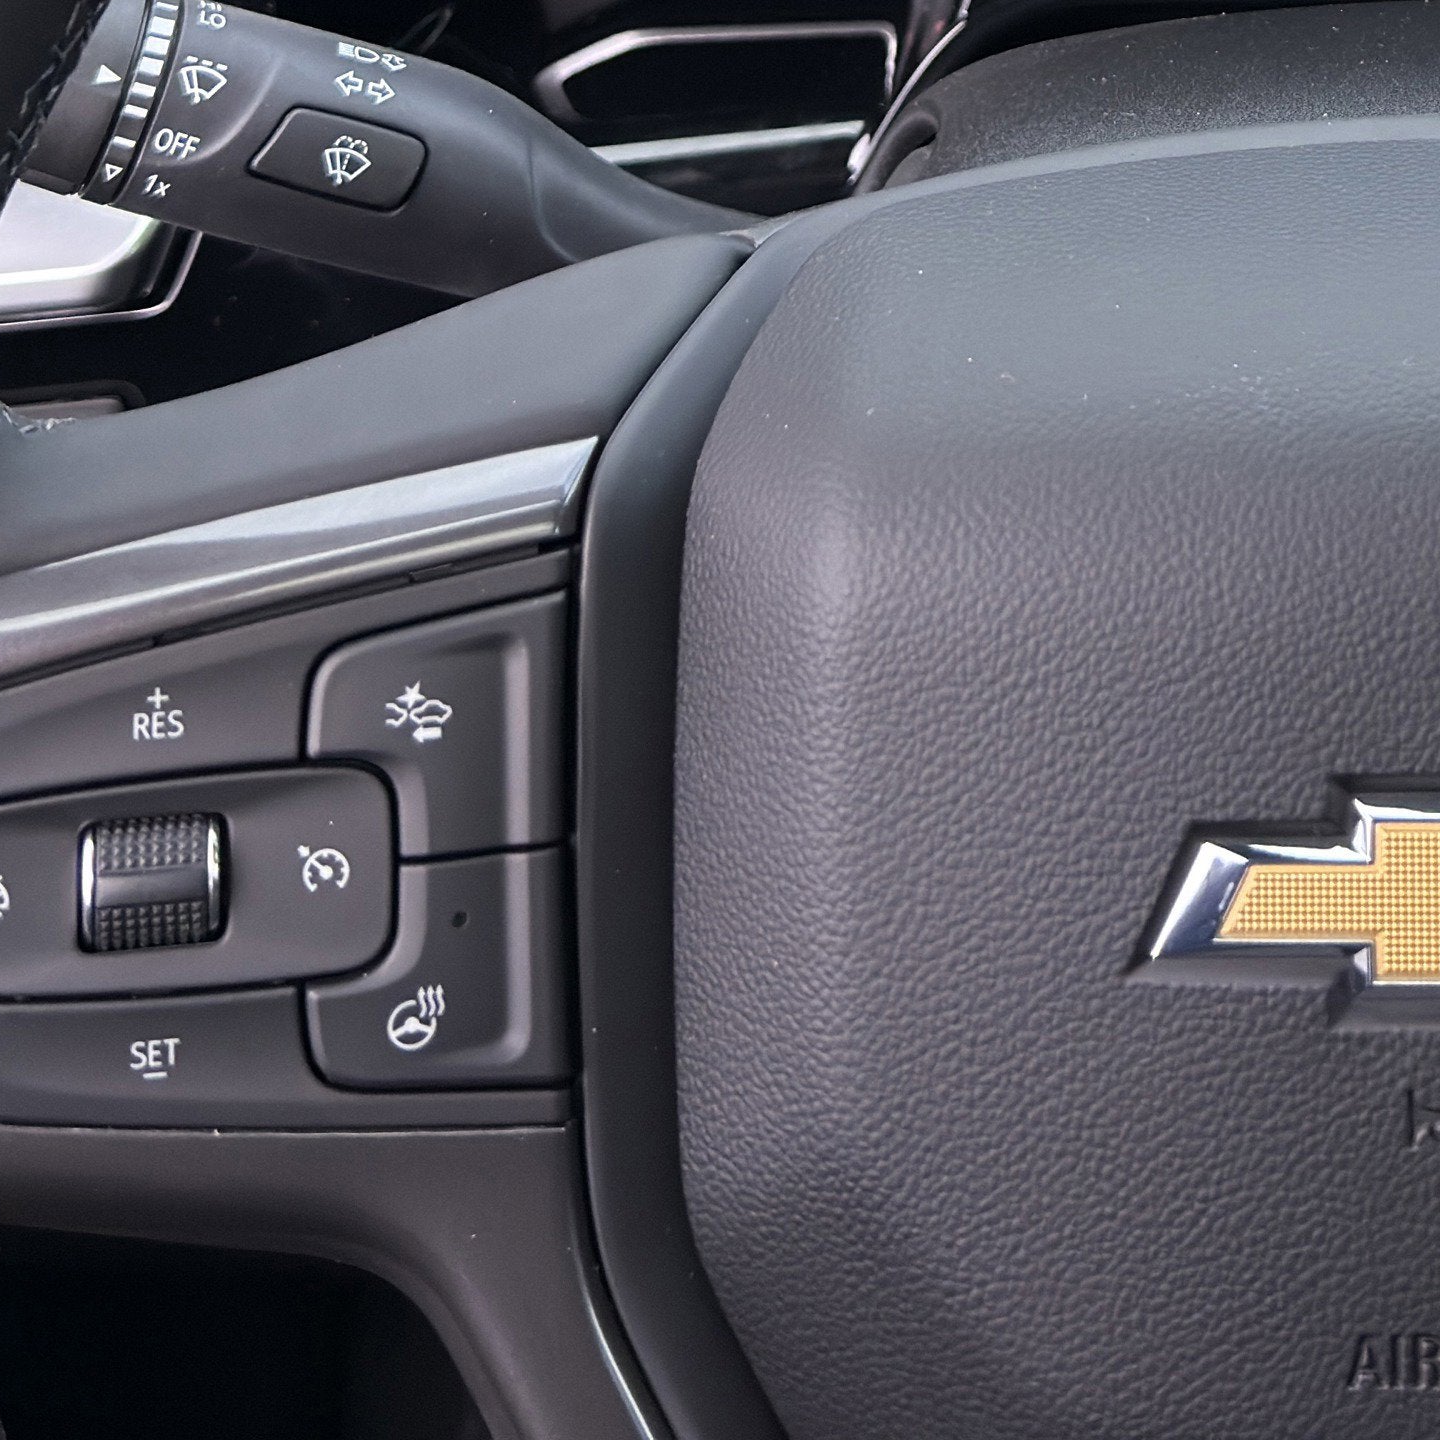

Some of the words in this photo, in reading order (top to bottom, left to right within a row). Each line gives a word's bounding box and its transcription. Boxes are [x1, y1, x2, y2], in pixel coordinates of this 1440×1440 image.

[153, 127, 201, 160] OFF
[143, 174, 171, 198] 1x
[132, 709, 185, 740] RES
[129, 1037, 180, 1067] SET
